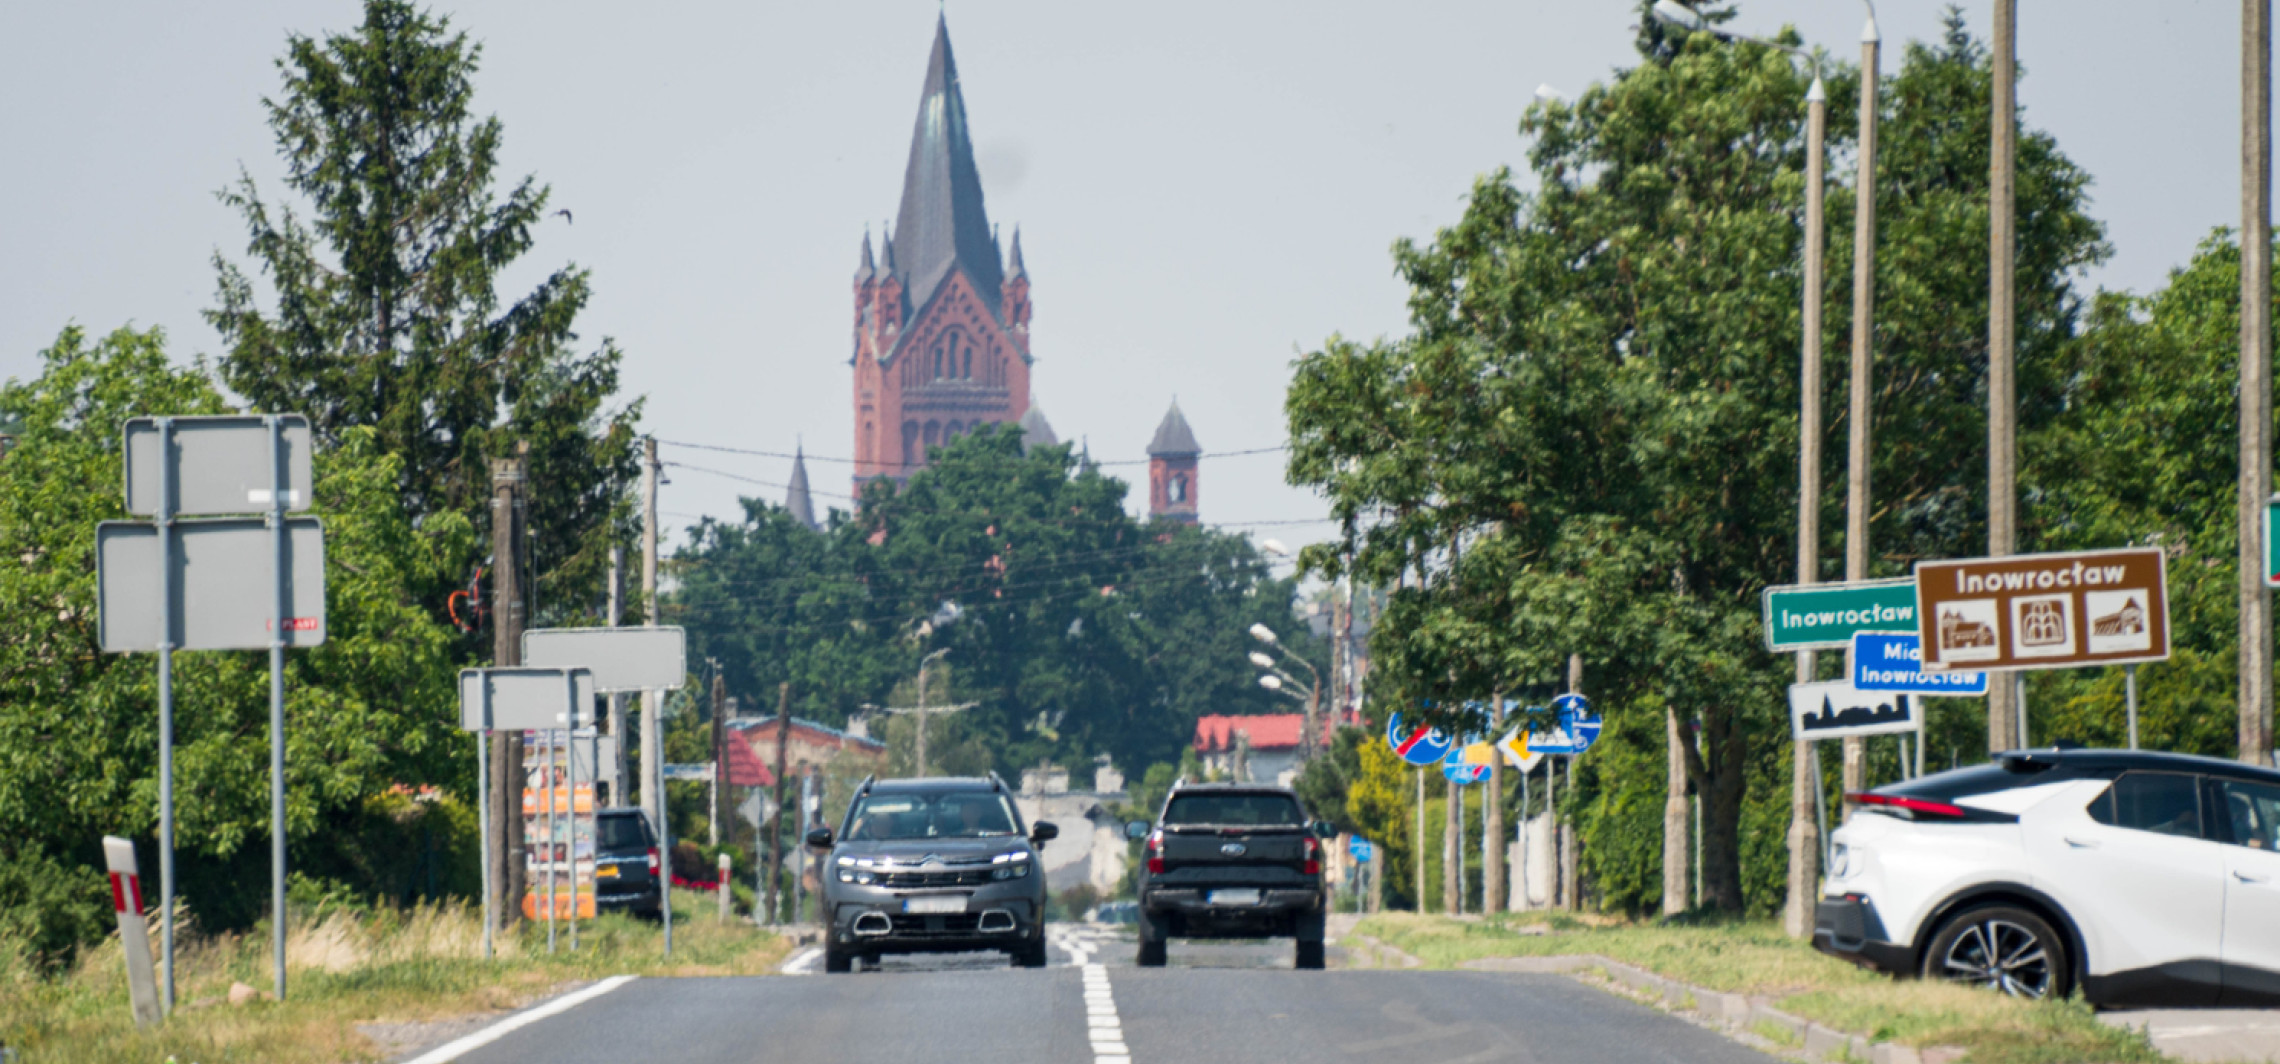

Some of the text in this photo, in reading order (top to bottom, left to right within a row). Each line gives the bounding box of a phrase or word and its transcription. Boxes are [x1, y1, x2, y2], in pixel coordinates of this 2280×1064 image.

[1956, 561, 2126, 593] Inowrocław
[1782, 602, 1914, 629] Inowrocław
[1884, 642, 1920, 660] Mia
